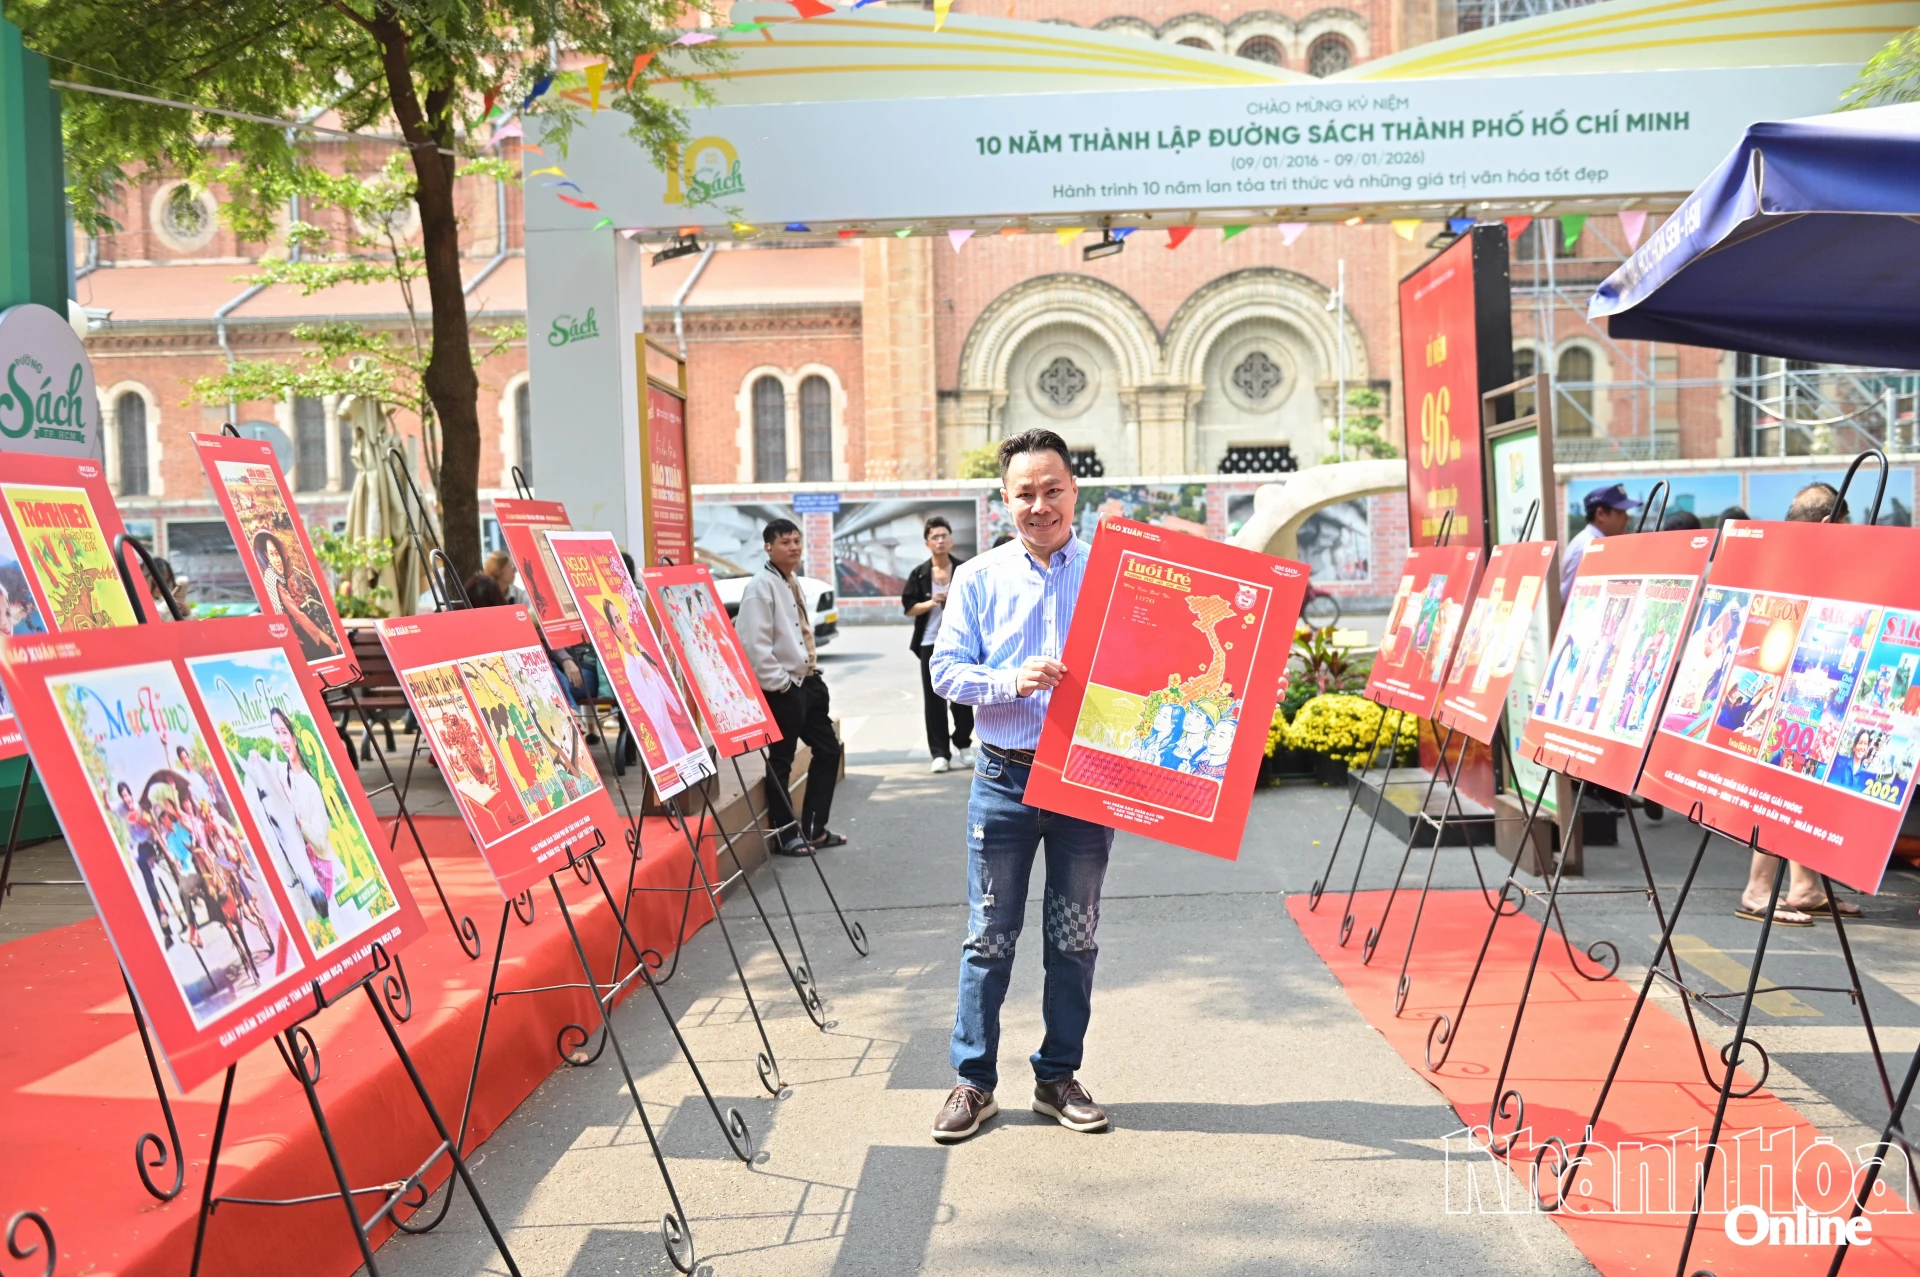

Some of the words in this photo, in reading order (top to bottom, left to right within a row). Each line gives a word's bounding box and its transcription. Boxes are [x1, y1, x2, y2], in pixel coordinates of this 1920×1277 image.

[1247, 99, 1290, 115] CHÀO
[1296, 98, 1342, 114] MỪNG
[1374, 96, 1409, 113] NIỆM
[976, 135, 1000, 155] 10
[1009, 130, 1062, 154] NĂM
[1069, 127, 1150, 151] THÀNH
[1158, 126, 1200, 154] LẬP
[1208, 121, 1300, 148] ĐƯỜNG
[1308, 119, 1374, 143] SÁCH
[1382, 116, 1464, 141] THÀNH
[1472, 110, 1524, 139] PHỐ
[1532, 108, 1568, 136] HỒ
[1576, 108, 1618, 134] CHÍ
[1626, 111, 1690, 133] MINH
[1231, 154, 1319, 171] (09/01/2016
[1335, 151, 1425, 168] 09/01/2026)
[1053, 182, 1096, 199] Hành
[1100, 181, 1138, 198] trình
[1143, 180, 1160, 196] 10
[1165, 180, 1201, 195] năm
[1206, 179, 1231, 194] lan
[1235, 176, 1265, 193] tỏa
[1270, 176, 1287, 191] trí
[1292, 174, 1329, 190] thức
[1335, 174, 1354, 189] và
[1359, 171, 1411, 191] những
[1418, 170, 1443, 190] giá
[1448, 169, 1466, 188] trị
[1471, 168, 1502, 184] văn
[1507, 166, 1540, 183] hóa
[1546, 164, 1569, 183] tốt
[1575, 167, 1609, 184] đẹp
[548, 307, 599, 347] Sách
[0, 363, 86, 439] Sách
[1421, 386, 1450, 469] 96
[1122, 526, 1142, 538] XUÂN
[1128, 558, 1162, 578] tuổi
[1164, 567, 1191, 586] trẻ
[1768, 718, 1814, 754] 300
[1862, 779, 1900, 803] 2002
